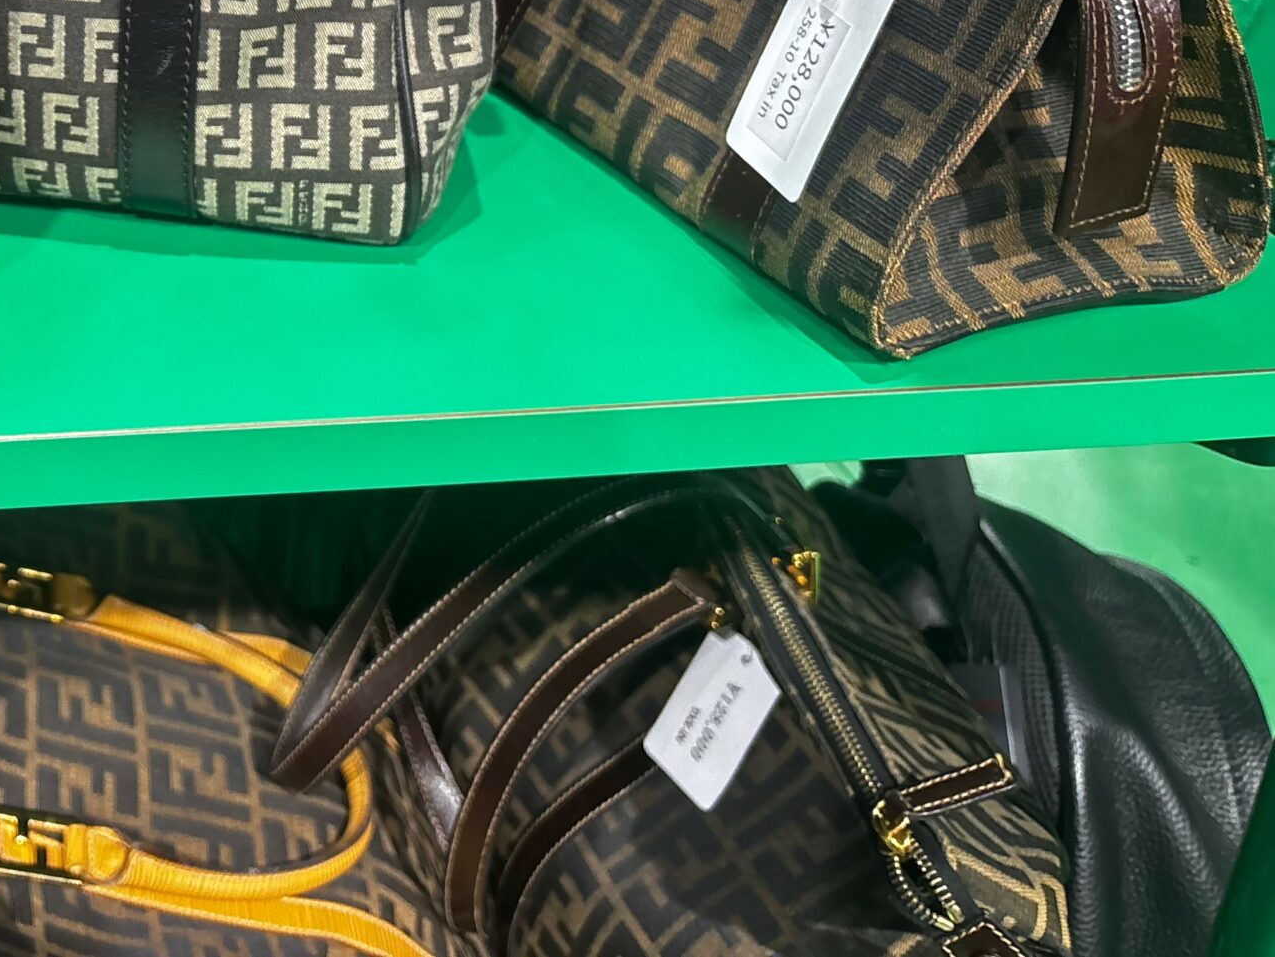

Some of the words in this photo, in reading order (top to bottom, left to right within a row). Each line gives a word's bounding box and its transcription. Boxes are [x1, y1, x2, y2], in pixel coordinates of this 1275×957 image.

[784, 6, 817, 63] 258-10
[766, 71, 787, 100] Tax
[774, 19, 836, 131] ¥128,000
[757, 100, 773, 119] in
